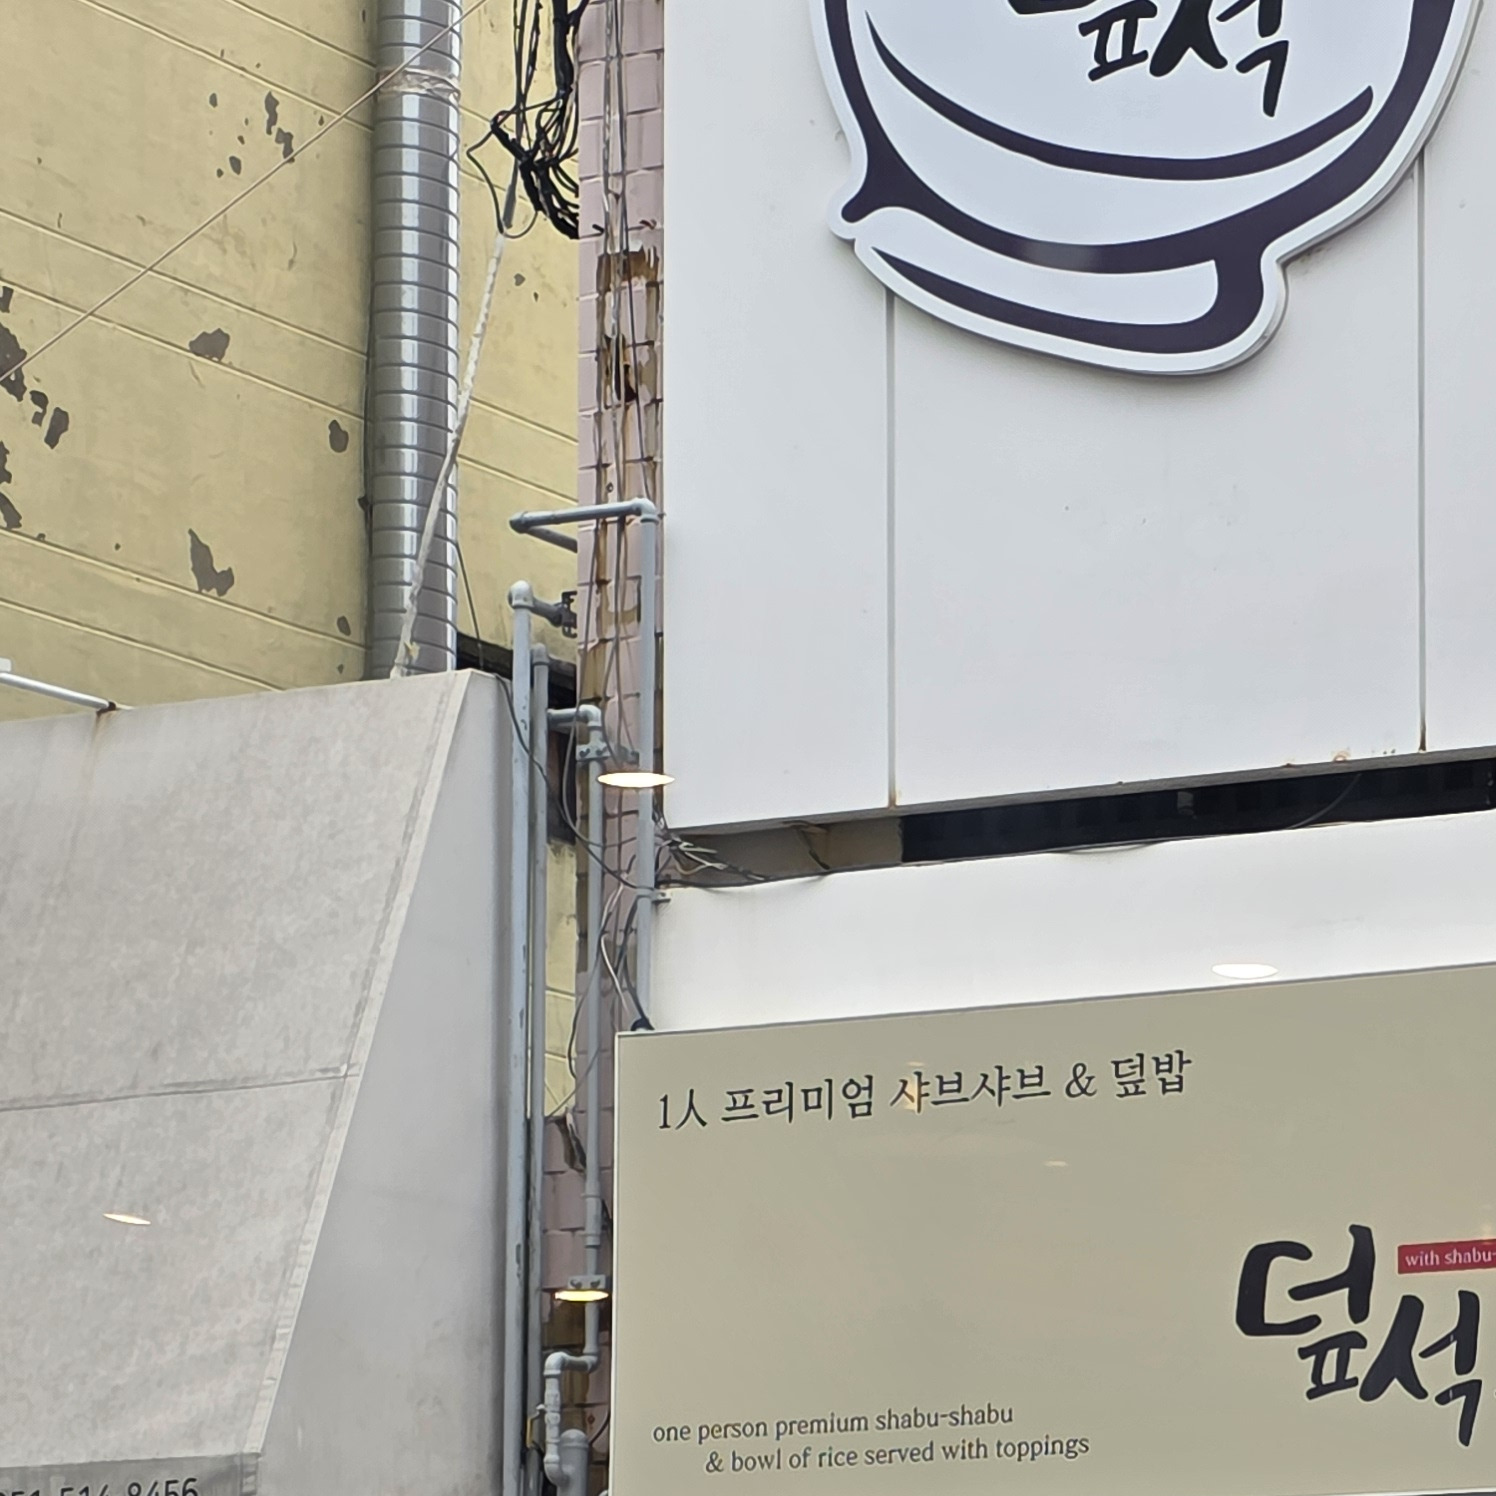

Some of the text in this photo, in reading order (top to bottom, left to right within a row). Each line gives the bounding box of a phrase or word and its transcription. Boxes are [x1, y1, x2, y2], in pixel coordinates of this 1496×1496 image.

[720, 1074, 875, 1124] 프리미엄
[889, 1065, 1052, 1115] 샤브샤브
[1065, 1062, 1098, 1099] &
[1110, 1049, 1193, 1099] 덮밥
[1405, 1250, 1441, 1268] with
[1235, 1223, 1483, 1448] 덮석
[652, 1402, 1015, 1445] one person premium shabu-shabu
[704, 1434, 1090, 1474] & bowl of rice served with toppings
